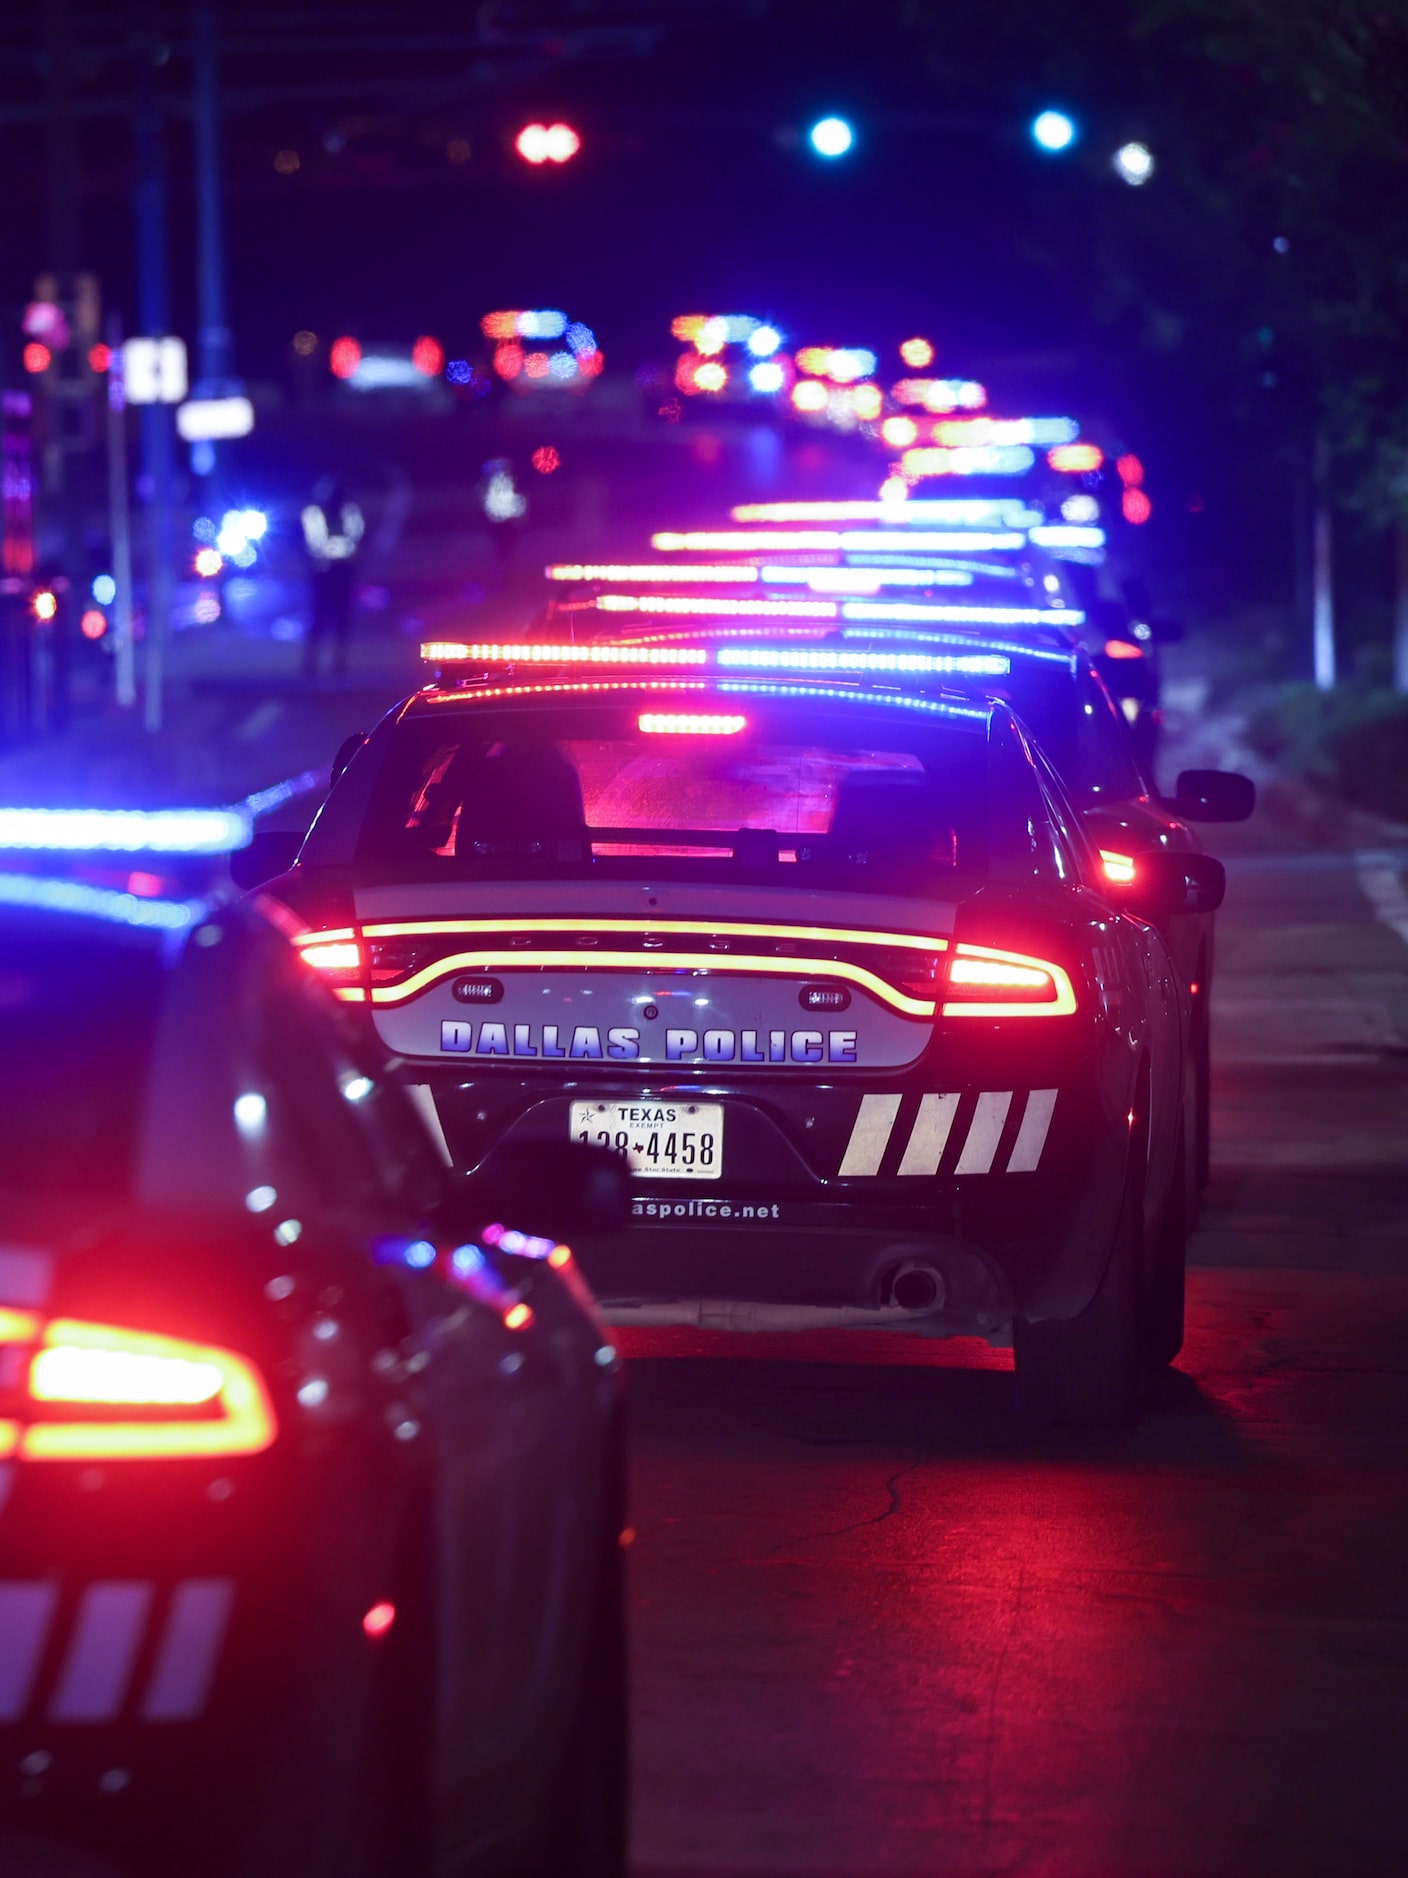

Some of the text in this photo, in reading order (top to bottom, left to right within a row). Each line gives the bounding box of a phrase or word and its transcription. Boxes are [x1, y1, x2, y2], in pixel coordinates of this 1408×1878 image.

[440, 1019, 858, 1062] DALLAS POLICE
[618, 1107, 676, 1122] TEXAS
[632, 1202, 779, 1219] aspolice.net
